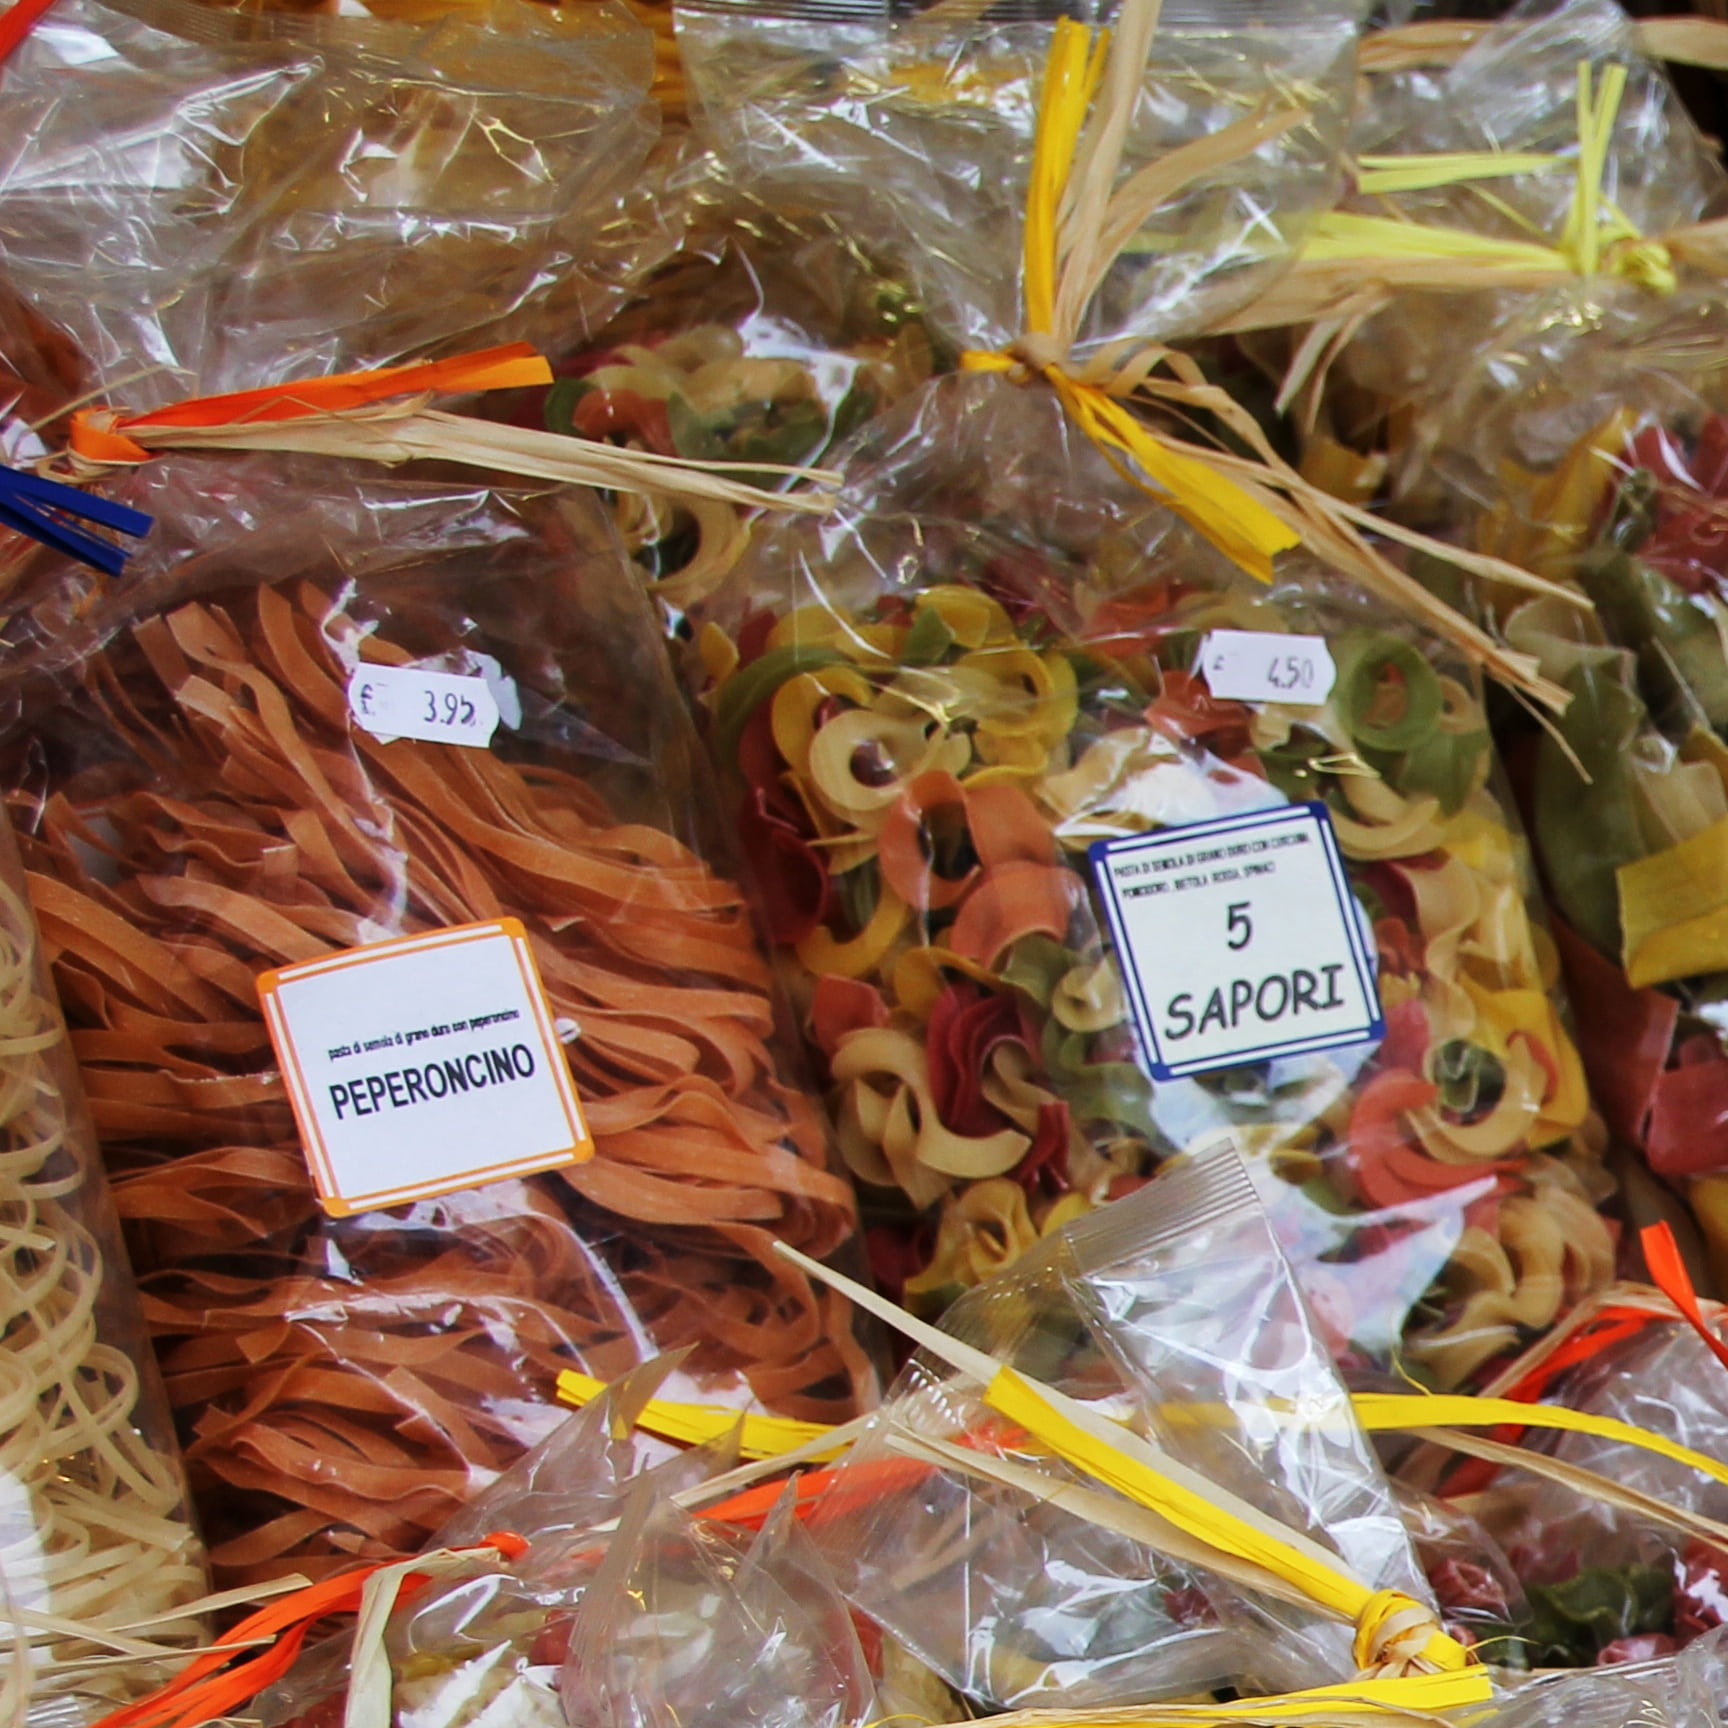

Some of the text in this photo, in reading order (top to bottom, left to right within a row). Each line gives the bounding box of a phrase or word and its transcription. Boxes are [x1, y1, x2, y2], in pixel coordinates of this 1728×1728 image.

[1226, 901, 1253, 950] 5
[1163, 964, 1346, 1041] SAPORI
[328, 1043, 536, 1120] PEPERONCINO
